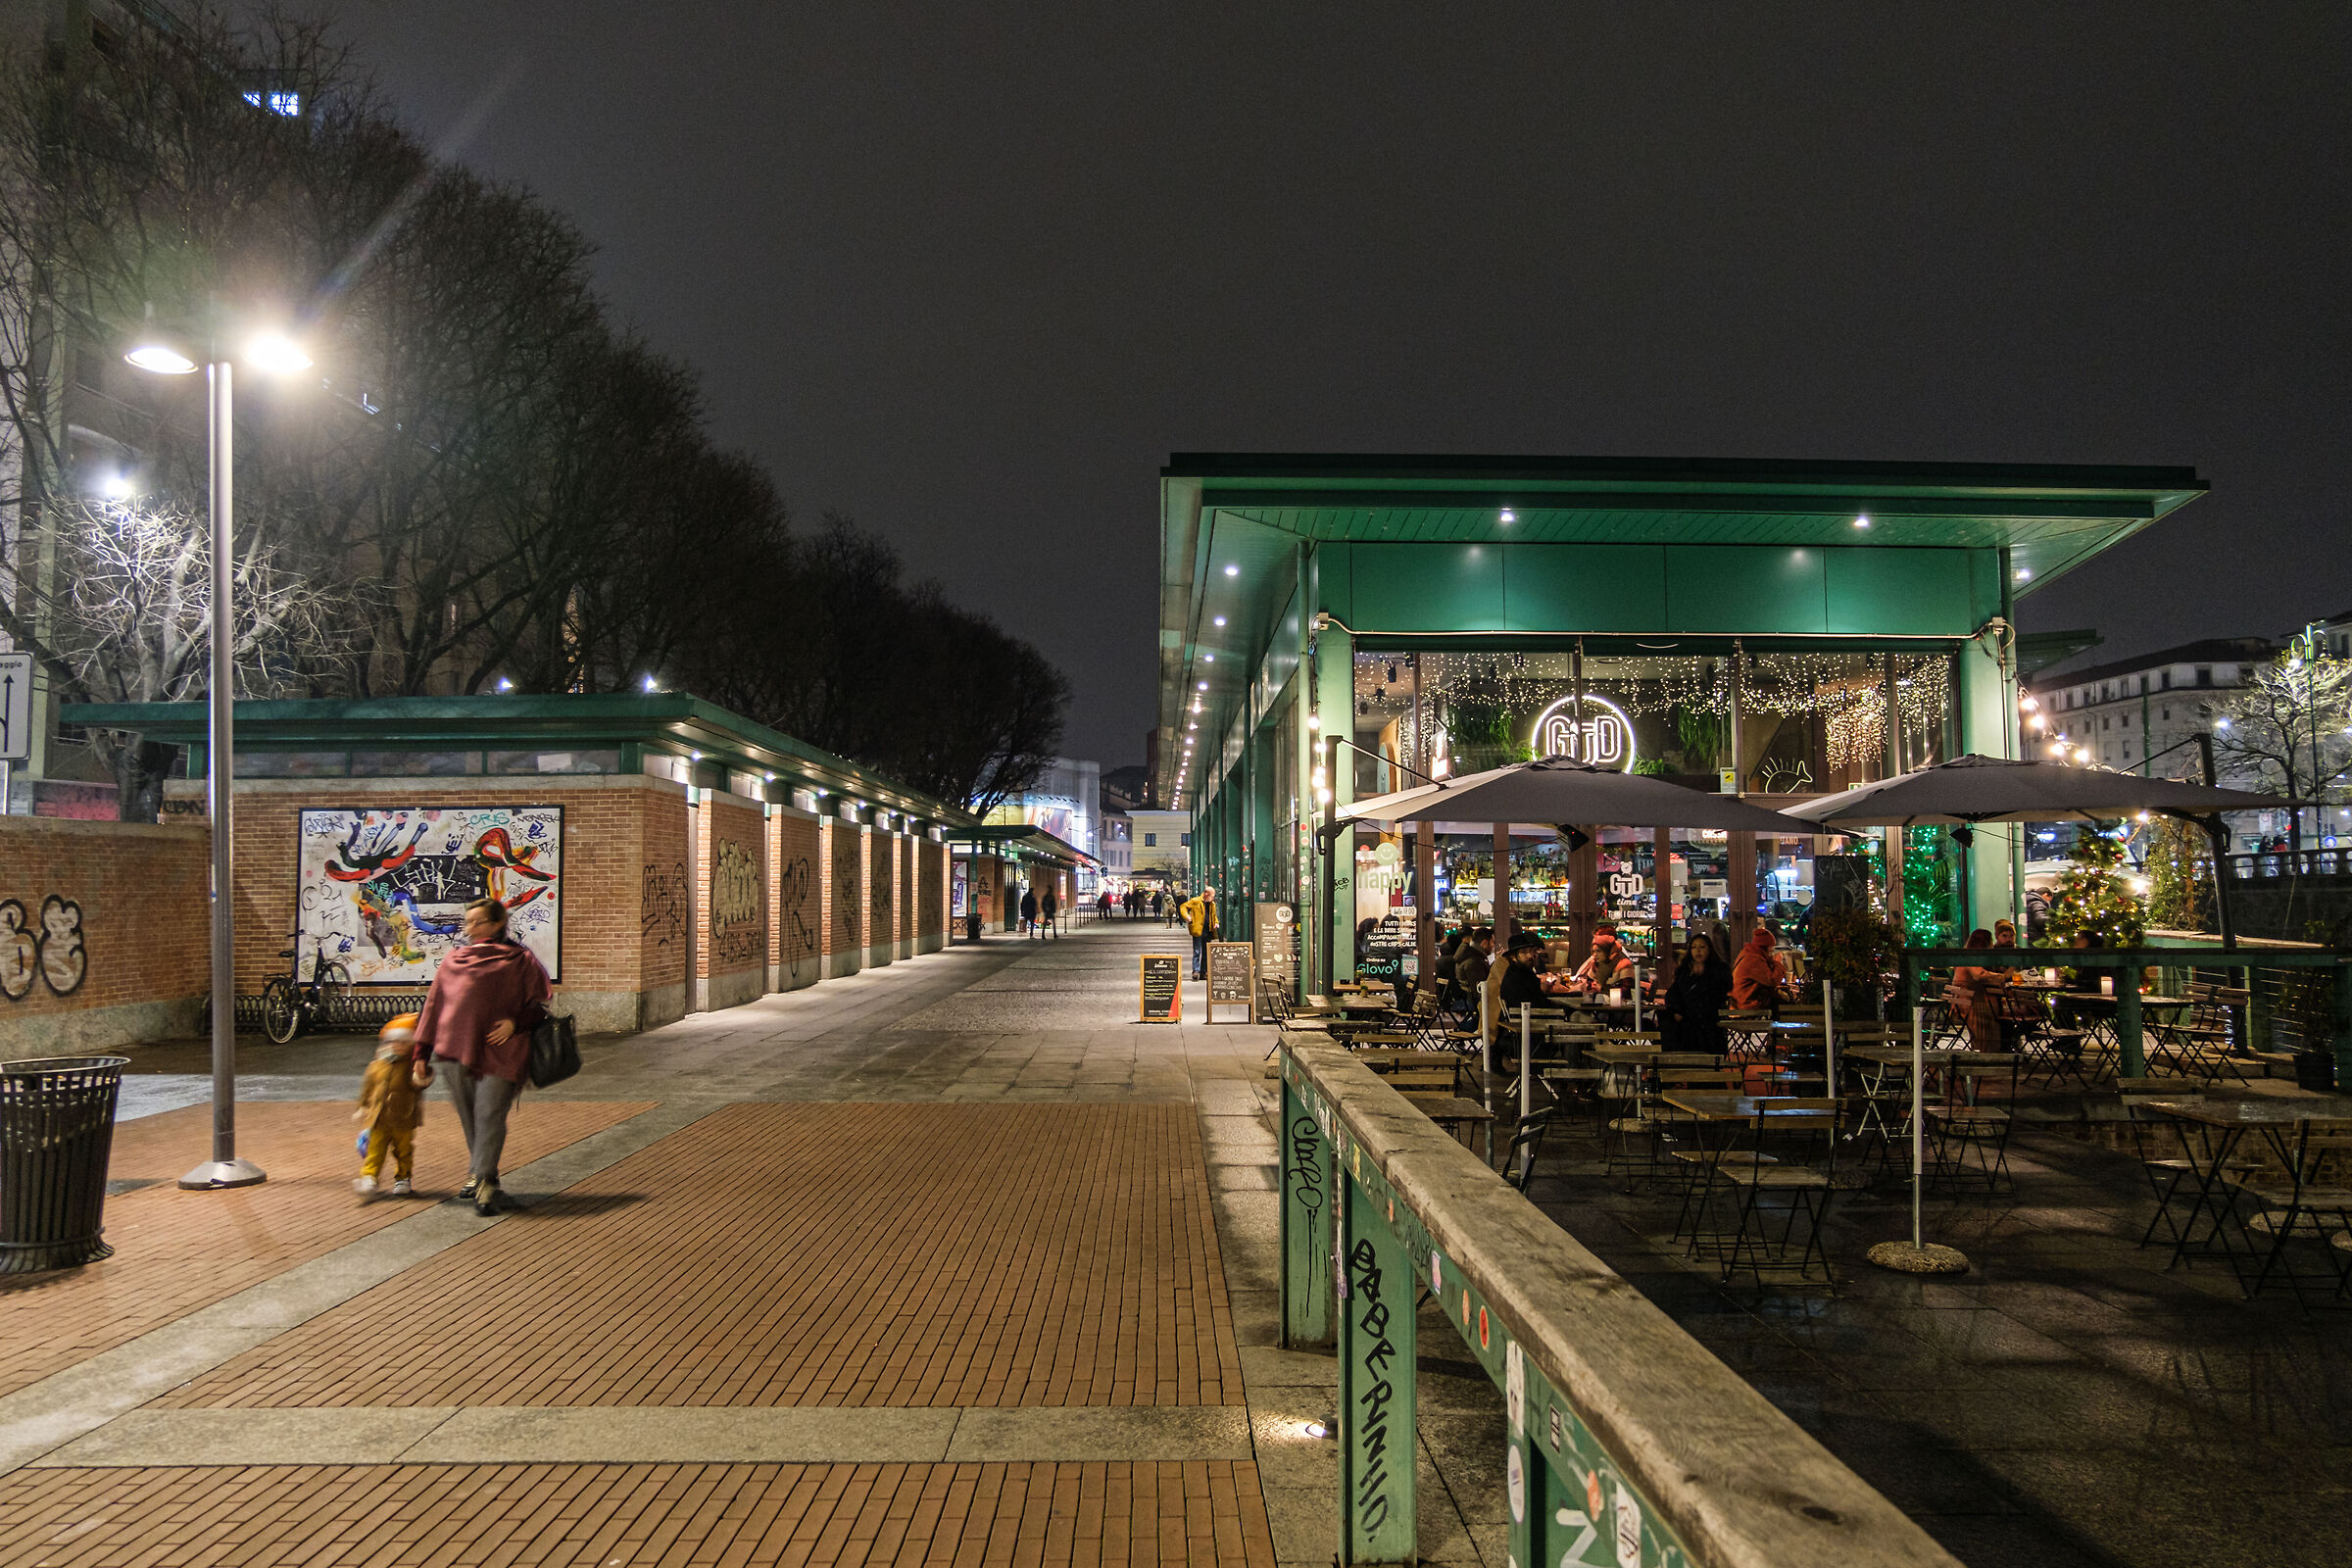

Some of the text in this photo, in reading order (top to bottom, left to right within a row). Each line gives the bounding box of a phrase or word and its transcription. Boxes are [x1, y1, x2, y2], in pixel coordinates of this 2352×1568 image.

[1357, 866, 1412, 896] happy
[1616, 898, 1638, 906] time
[1356, 962, 1394, 974] Glovo
